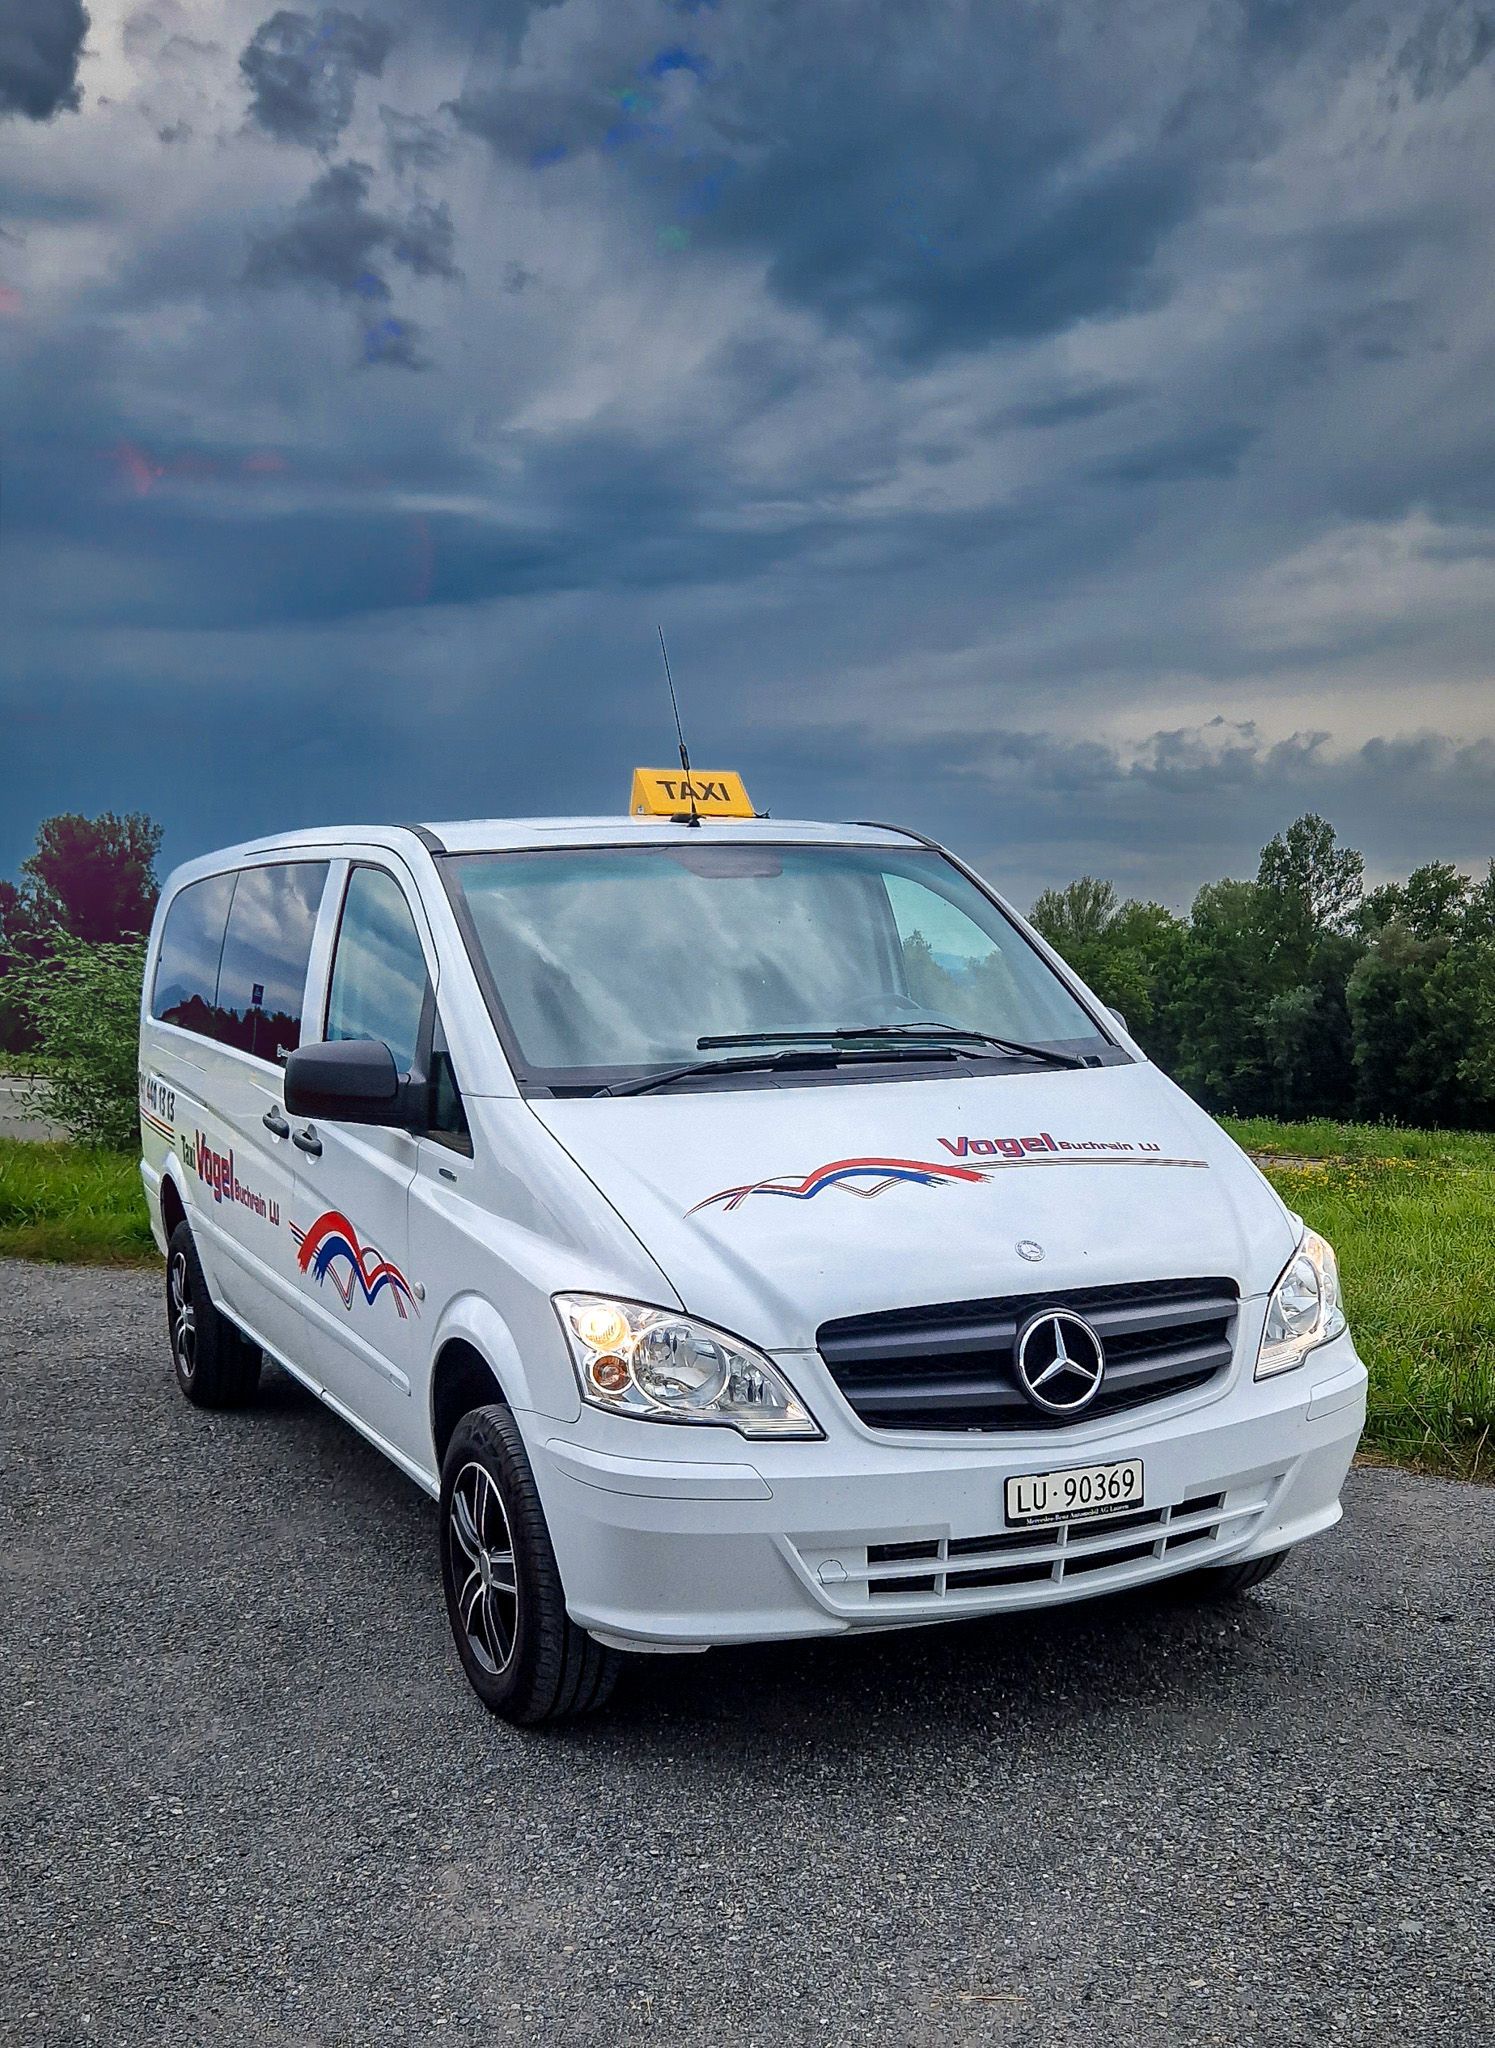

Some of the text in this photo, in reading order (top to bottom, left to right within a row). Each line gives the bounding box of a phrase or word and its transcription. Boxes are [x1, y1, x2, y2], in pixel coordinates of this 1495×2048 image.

[656, 780, 731, 801] TAXI
[937, 1132, 1161, 1158] Vogel Buchrain LU
[181, 1128, 280, 1226] Taxi Vogel Buchrain LU
